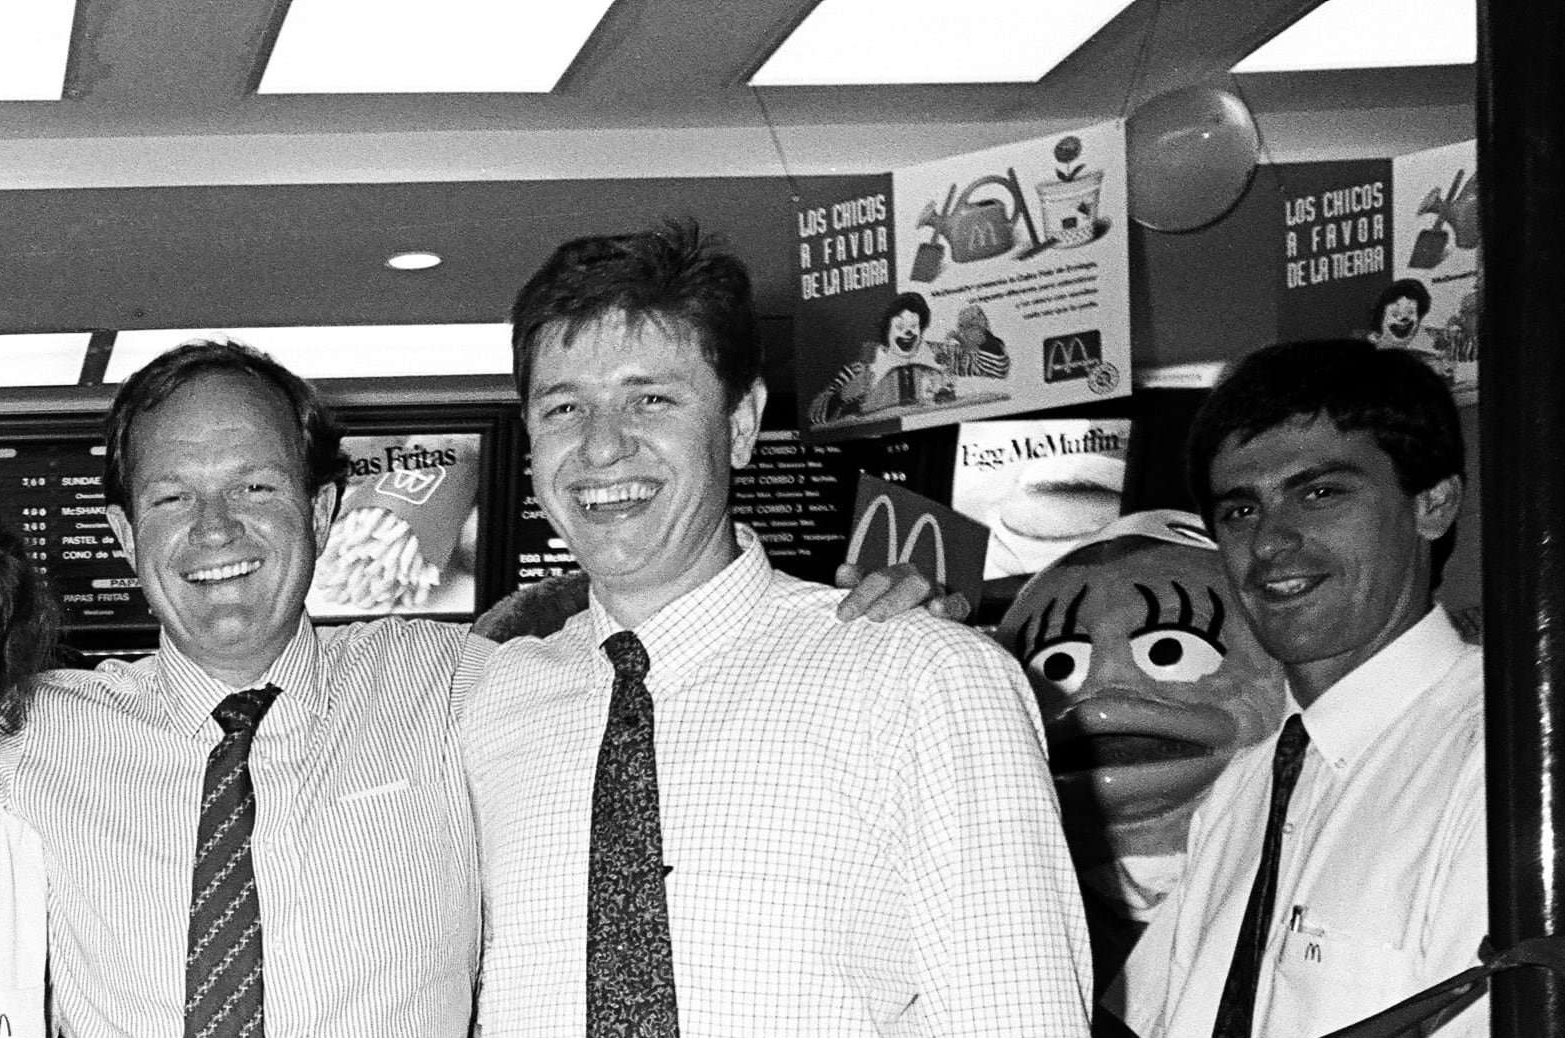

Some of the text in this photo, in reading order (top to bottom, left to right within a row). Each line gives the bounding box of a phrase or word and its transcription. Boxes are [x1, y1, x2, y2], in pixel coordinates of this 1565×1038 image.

[798, 194, 886, 238] LOS CHICOS
[1286, 181, 1383, 226] LOS CHICOS
[801, 227, 887, 270] A FAVOR
[1287, 214, 1383, 258] A FAVOR
[802, 258, 888, 300] DE LA TIERRA
[1287, 245, 1384, 288] DE LA TIERRA
[385, 443, 457, 472] Fritas
[962, 427, 1120, 471] Egg McMuffin
[62, 535, 99, 545] PASTEL
[62, 550, 92, 560] CONO
[63, 592, 130, 602] PAPAS FRITAS
